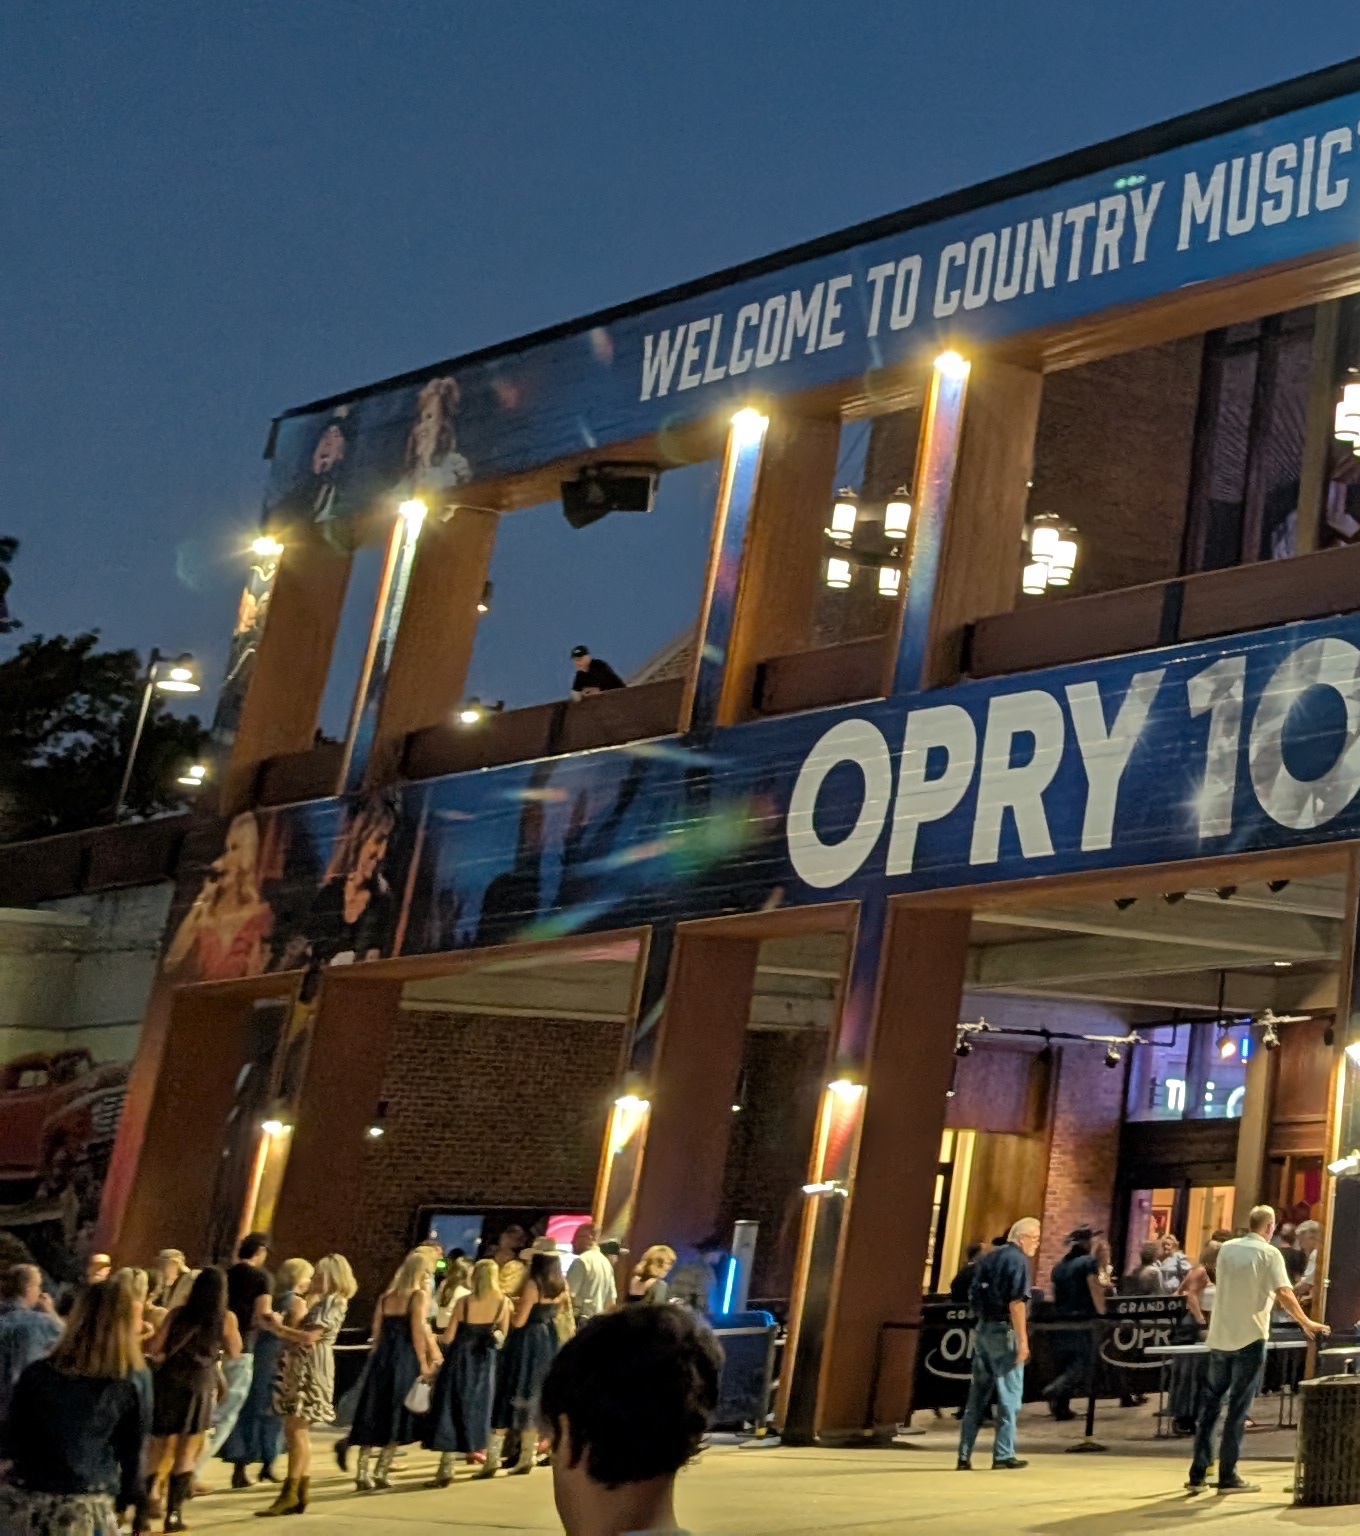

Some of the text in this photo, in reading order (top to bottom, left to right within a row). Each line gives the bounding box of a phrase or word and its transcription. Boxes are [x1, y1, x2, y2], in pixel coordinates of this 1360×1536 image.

[640, 274, 852, 401] WELCOME
[867, 254, 922, 338] TO
[932, 181, 1165, 320] COUNTRY
[787, 668, 1166, 889] OPRY
[1113, 1316, 1178, 1351] OPR
